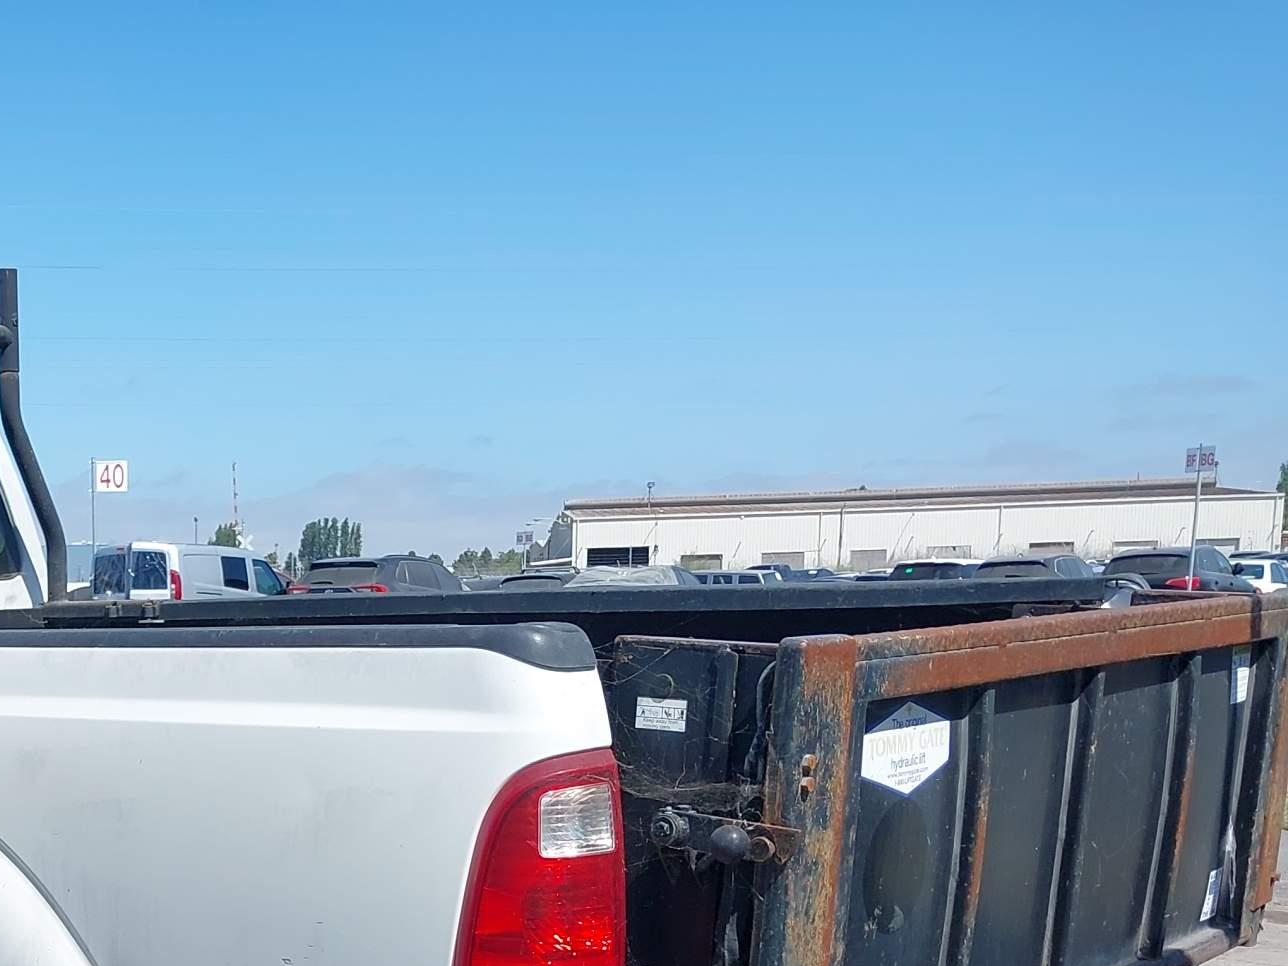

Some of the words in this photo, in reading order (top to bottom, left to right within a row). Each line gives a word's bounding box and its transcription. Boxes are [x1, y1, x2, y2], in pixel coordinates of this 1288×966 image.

[1201, 453, 1214, 466] BG
[100, 463, 124, 488] 40
[868, 730, 915, 761] TOMMY
[919, 727, 945, 750] GATE
